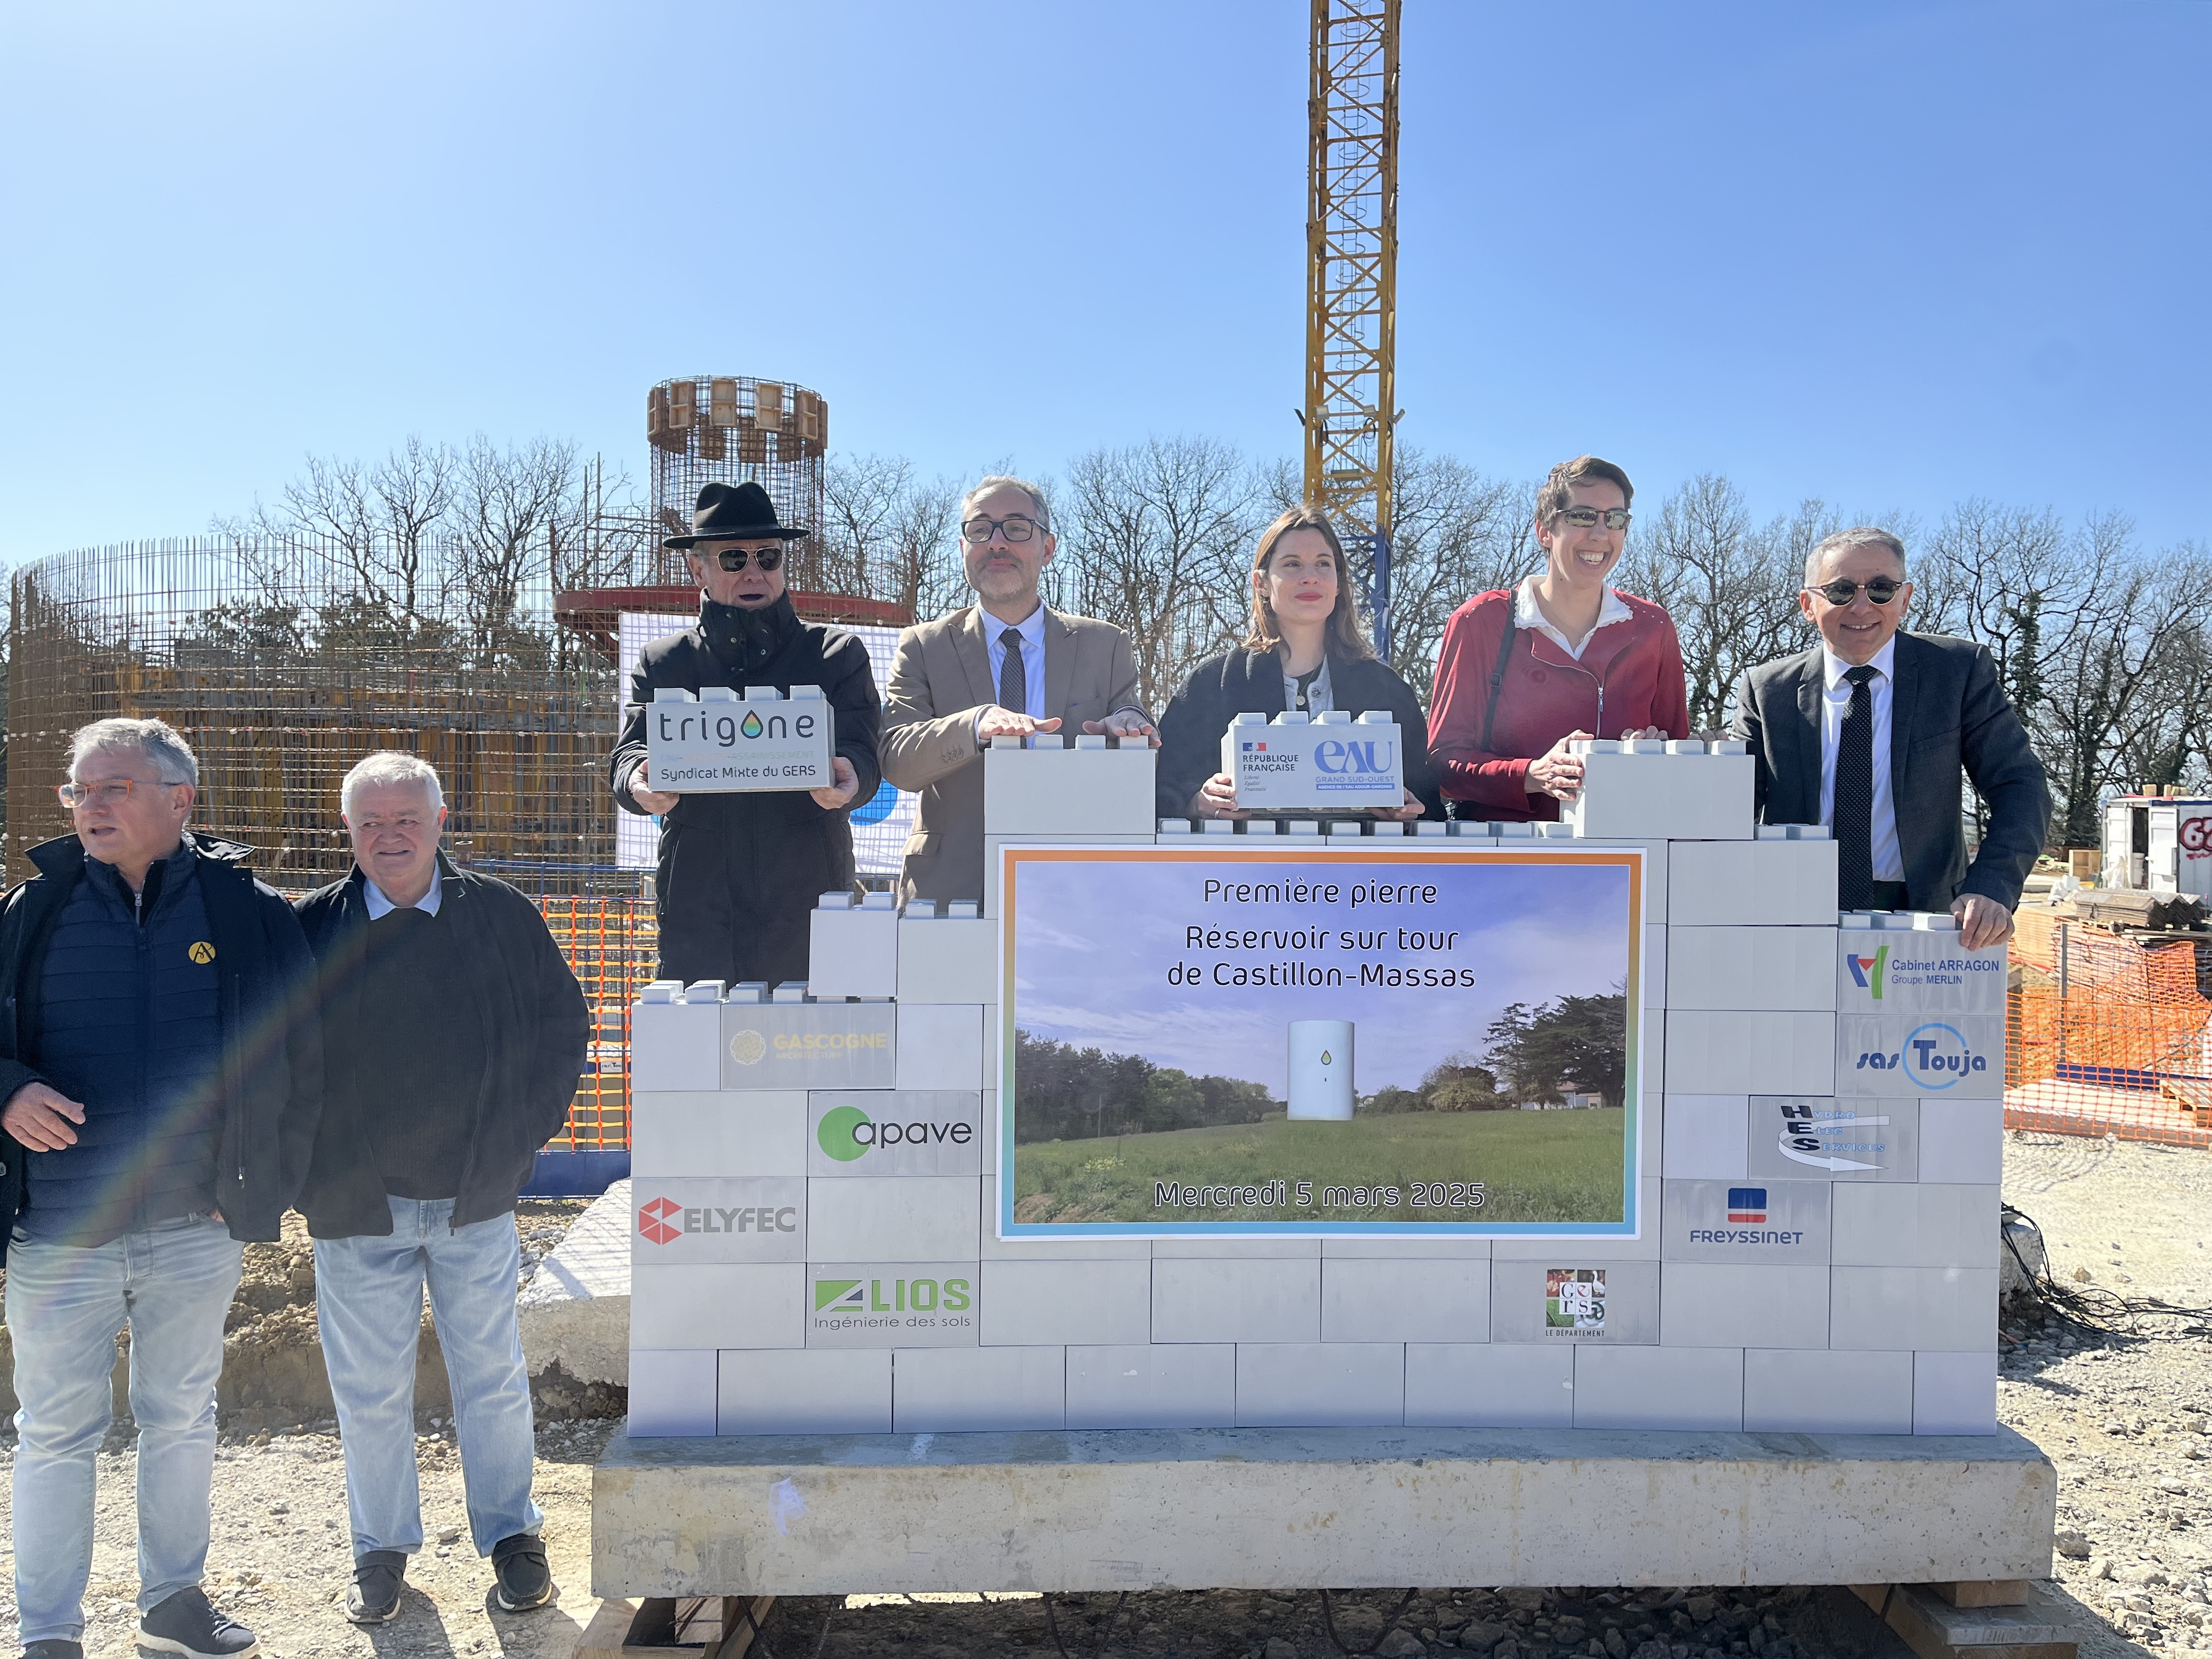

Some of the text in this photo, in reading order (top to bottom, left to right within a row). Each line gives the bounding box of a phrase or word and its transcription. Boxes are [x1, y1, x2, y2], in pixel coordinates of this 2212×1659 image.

[1243, 754, 1299, 763] RÉPUBLIQUE
[661, 765, 816, 781] Syndicat Mixte du GERS
[1243, 764, 1295, 772] FRANÇAISE
[1204, 877, 1438, 909] Première pierre
[1186, 923, 1459, 951] Réservoir sur tour
[1892, 959, 2000, 972] Cabinet ARRAGON
[1167, 960, 1475, 988] de Castillon-Massas
[1892, 975, 1963, 985] Groupe MERLIN
[774, 1033, 887, 1049] GASCOGNE
[1857, 1040, 1987, 1077] sas Touja
[852, 1122, 972, 1149] apave
[1155, 1180, 1485, 1207] Mercredi 5 mars 2025
[684, 1207, 796, 1233] ELYFEC
[815, 1316, 970, 1330] Ingénierie des sols
[1556, 1329, 1605, 1337] DÉPARTEMENT
